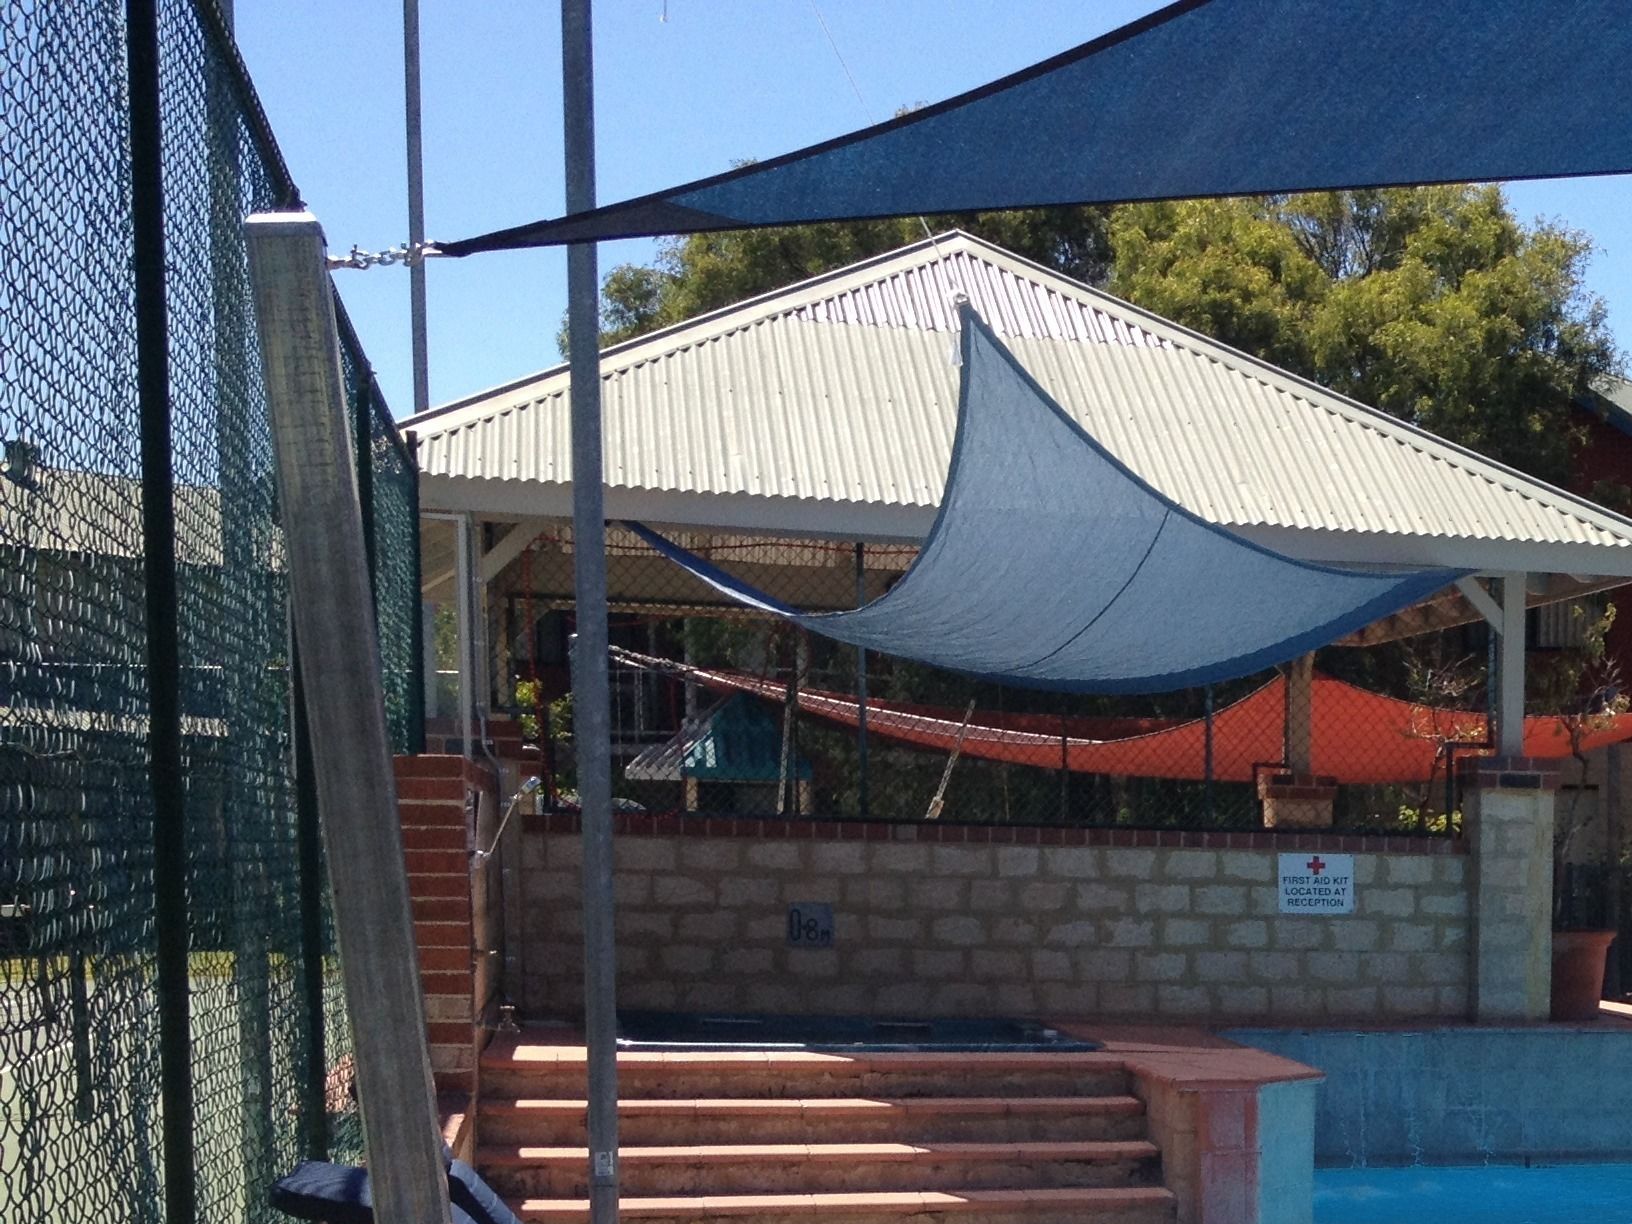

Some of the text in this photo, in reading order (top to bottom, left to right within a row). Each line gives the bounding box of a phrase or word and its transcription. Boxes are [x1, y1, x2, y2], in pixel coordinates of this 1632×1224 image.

[1282, 876, 1349, 885] FIRST AID KIT
[1285, 887, 1347, 896] LOCATED AT
[1287, 898, 1345, 907] RECEPTION
